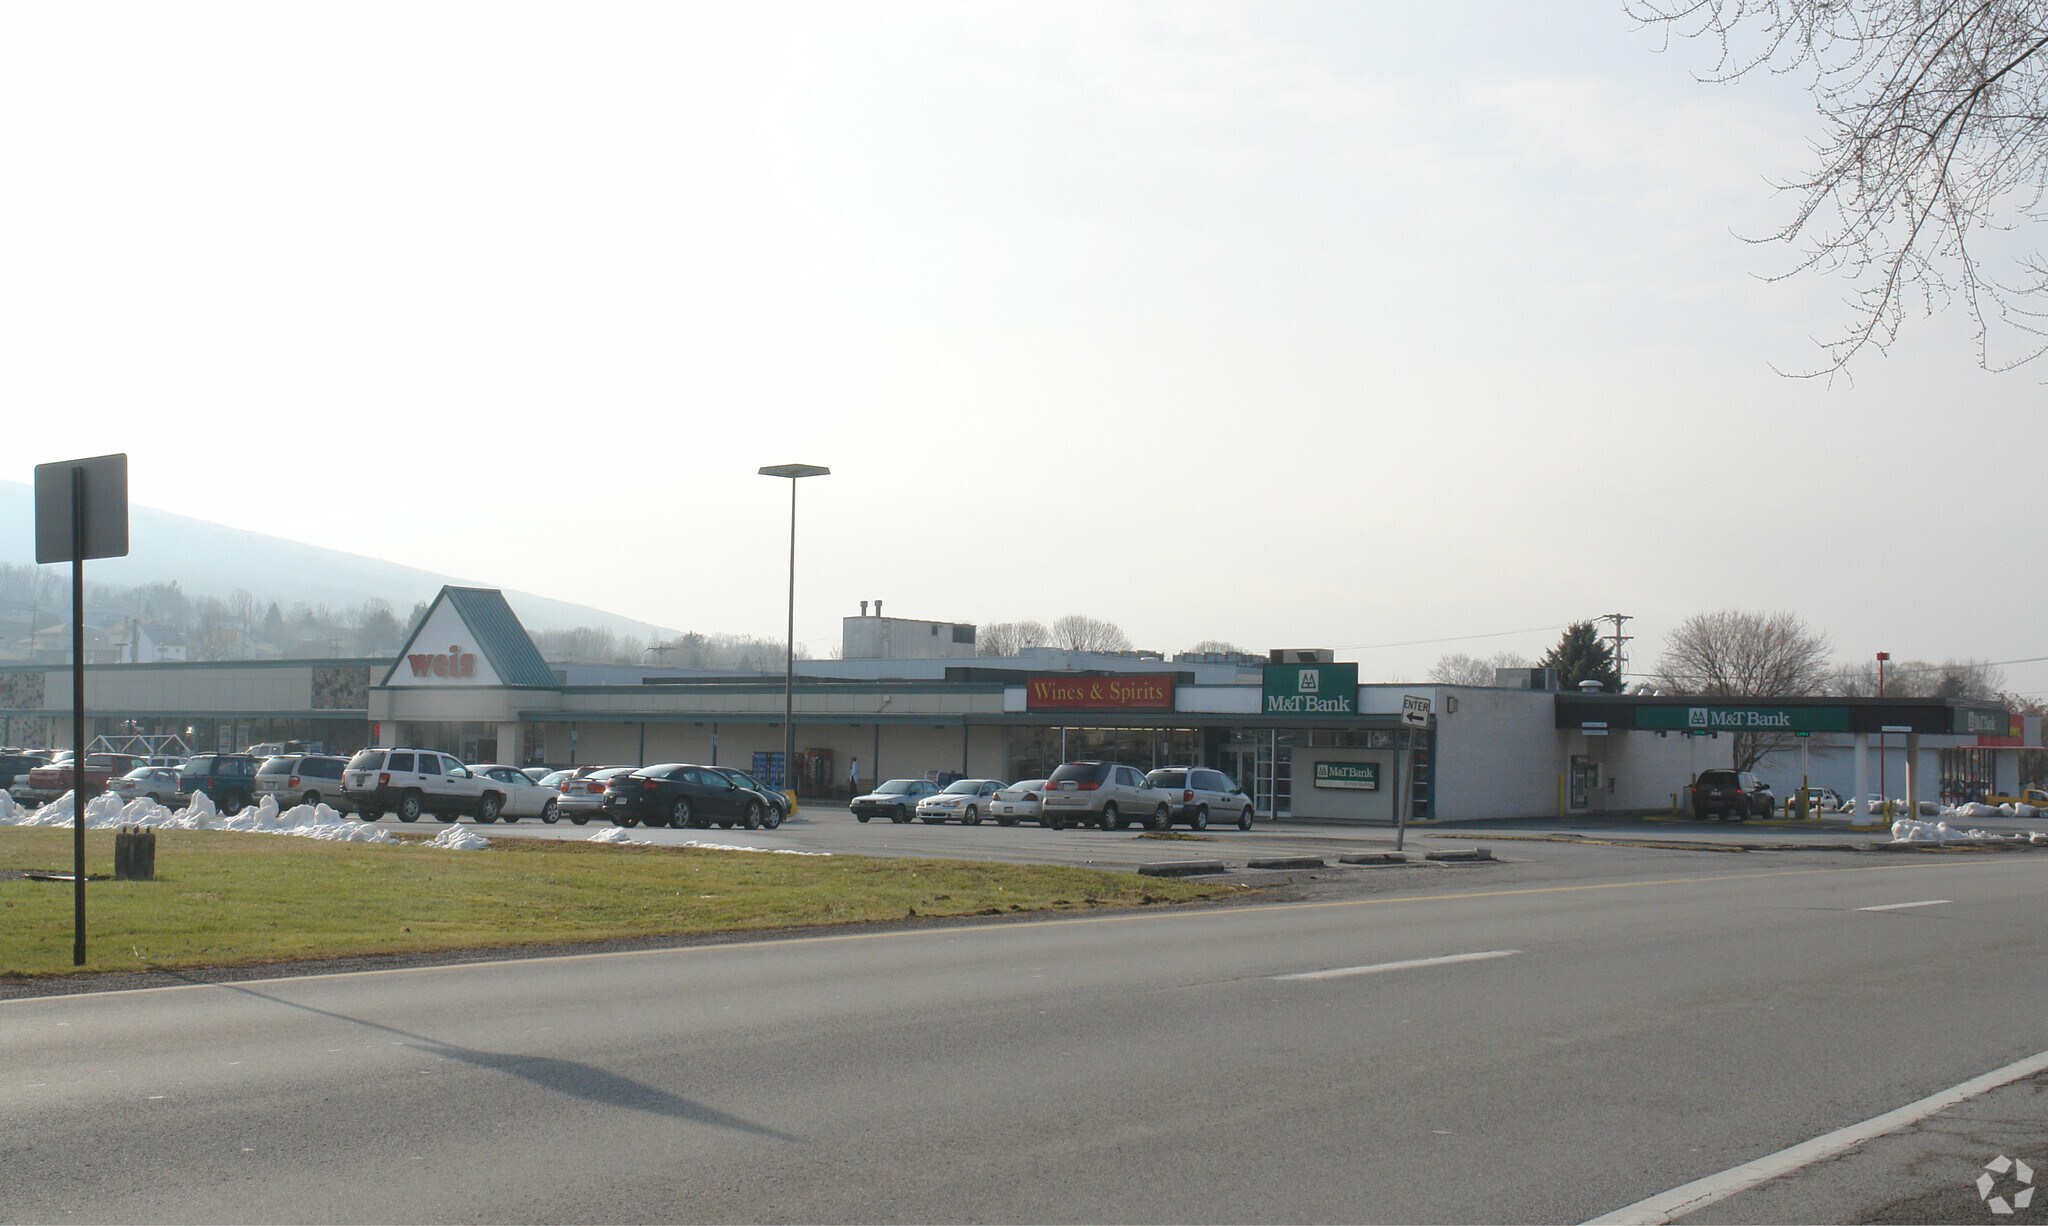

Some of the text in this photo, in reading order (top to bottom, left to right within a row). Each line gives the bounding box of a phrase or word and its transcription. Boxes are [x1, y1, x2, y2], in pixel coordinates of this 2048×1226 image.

[407, 645, 475, 677] weis
[1034, 681, 1163, 703] Wines & Spirits
[1267, 695, 1350, 712] M&T Bank
[1404, 699, 1429, 712] ENTER
[1710, 711, 1790, 726] M&T Bank
[1329, 766, 1374, 778] M&T Bank
